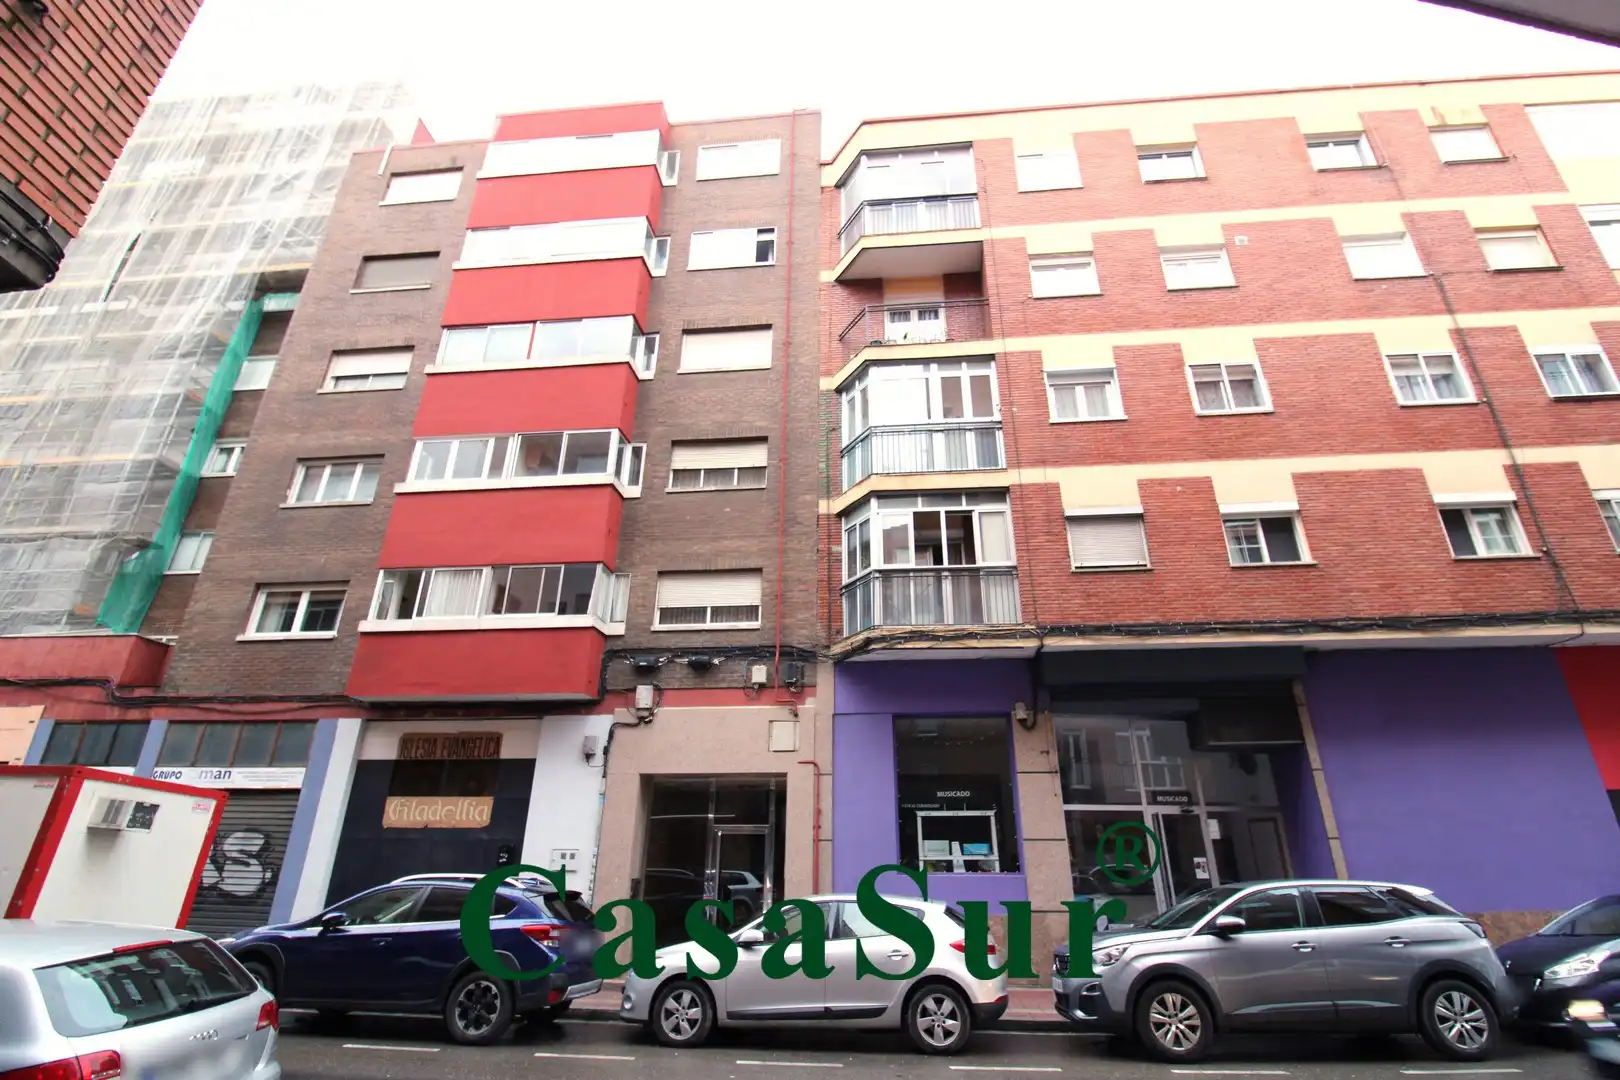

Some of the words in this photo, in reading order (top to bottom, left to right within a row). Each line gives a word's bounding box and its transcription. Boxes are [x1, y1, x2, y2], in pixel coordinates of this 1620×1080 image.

[400, 737, 437, 759] IGLESIA
[441, 736, 501, 759] EVANGELICA
[152, 770, 183, 780] GRUPO
[936, 790, 971, 798] MUSICADO
[1156, 795, 1189, 803] MUSICADO
